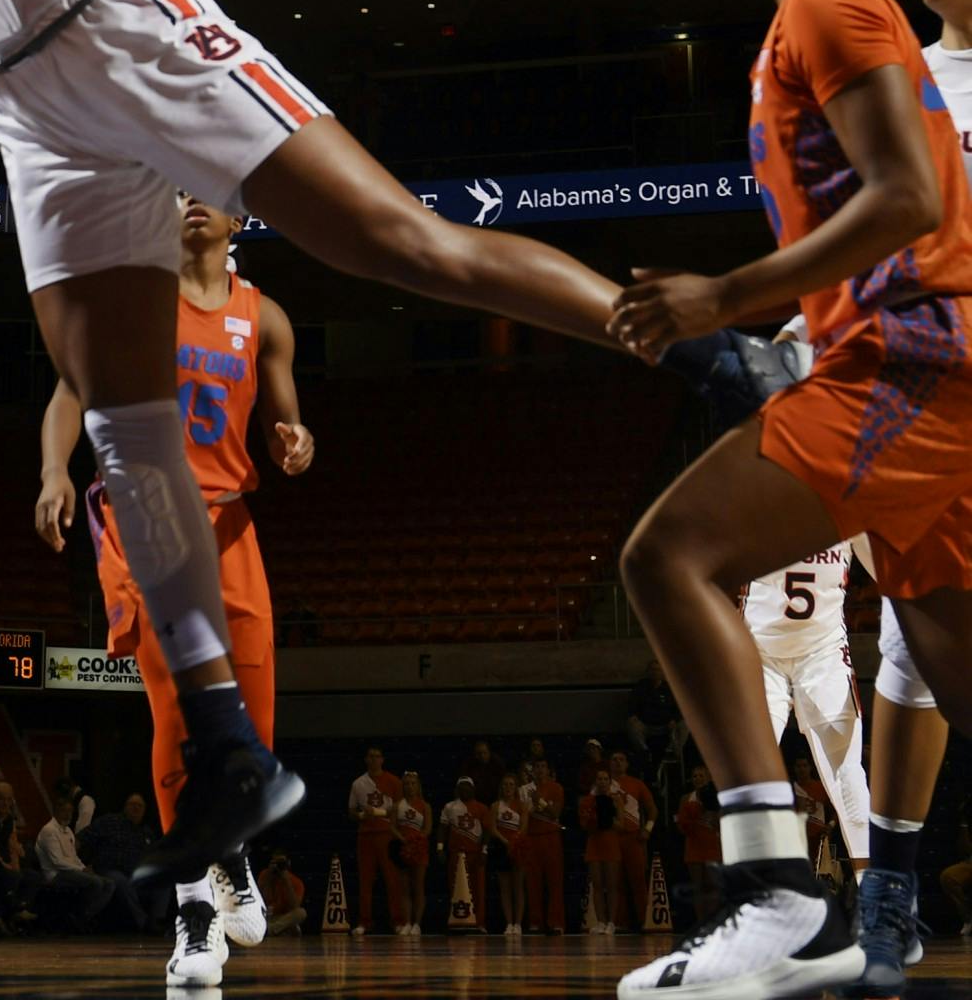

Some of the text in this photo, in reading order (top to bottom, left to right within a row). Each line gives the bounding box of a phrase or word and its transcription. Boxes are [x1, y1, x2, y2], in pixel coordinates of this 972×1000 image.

[638, 180, 709, 204] Organ
[715, 176, 732, 197] &
[177, 380, 228, 445] 15
[784, 571, 816, 620] 5
[8, 655, 34, 679] 78
[77, 673, 142, 684] PEST CONTRO
[419, 654, 431, 679] F
[329, 858, 344, 924] TIGERS
[652, 857, 669, 924] TIGERS
